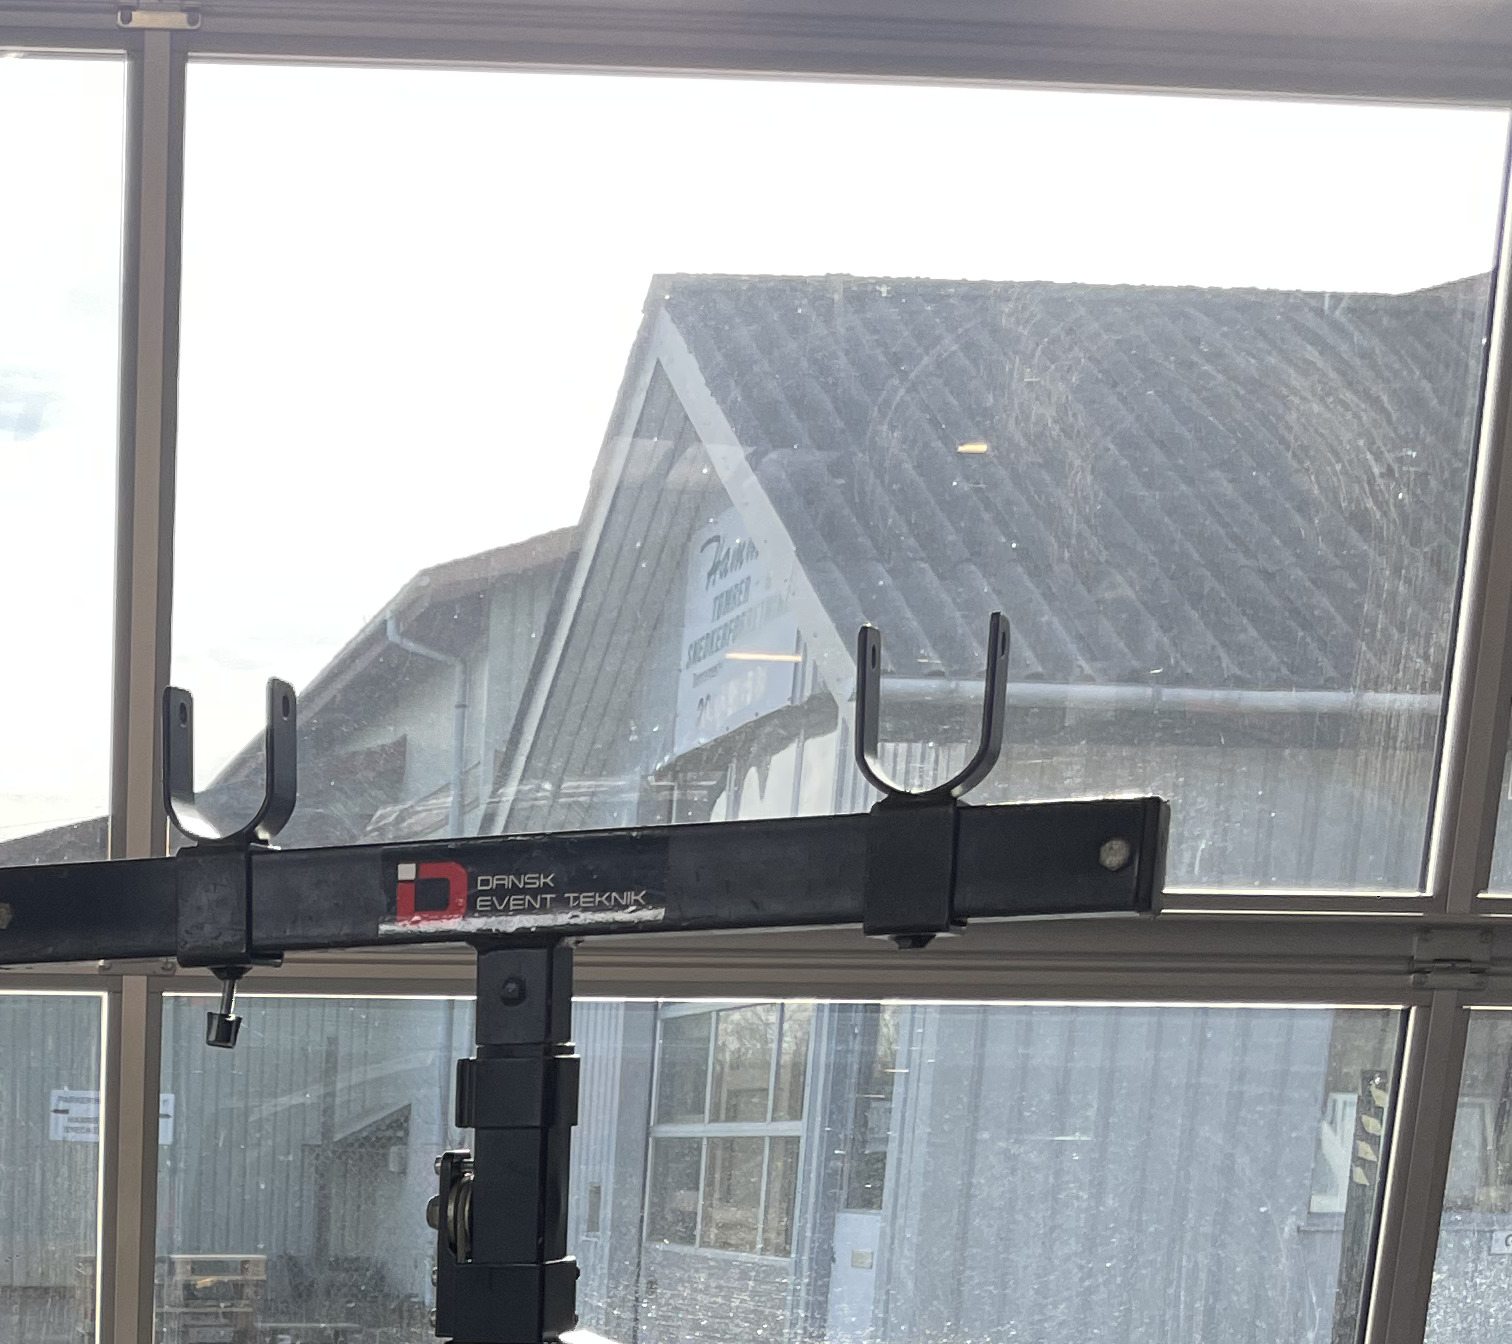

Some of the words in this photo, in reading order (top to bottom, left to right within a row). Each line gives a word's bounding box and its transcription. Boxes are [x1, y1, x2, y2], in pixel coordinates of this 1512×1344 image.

[477, 874, 555, 890] DANSK
[476, 893, 556, 911] EVENT
[564, 890, 648, 907] TEKNIK
